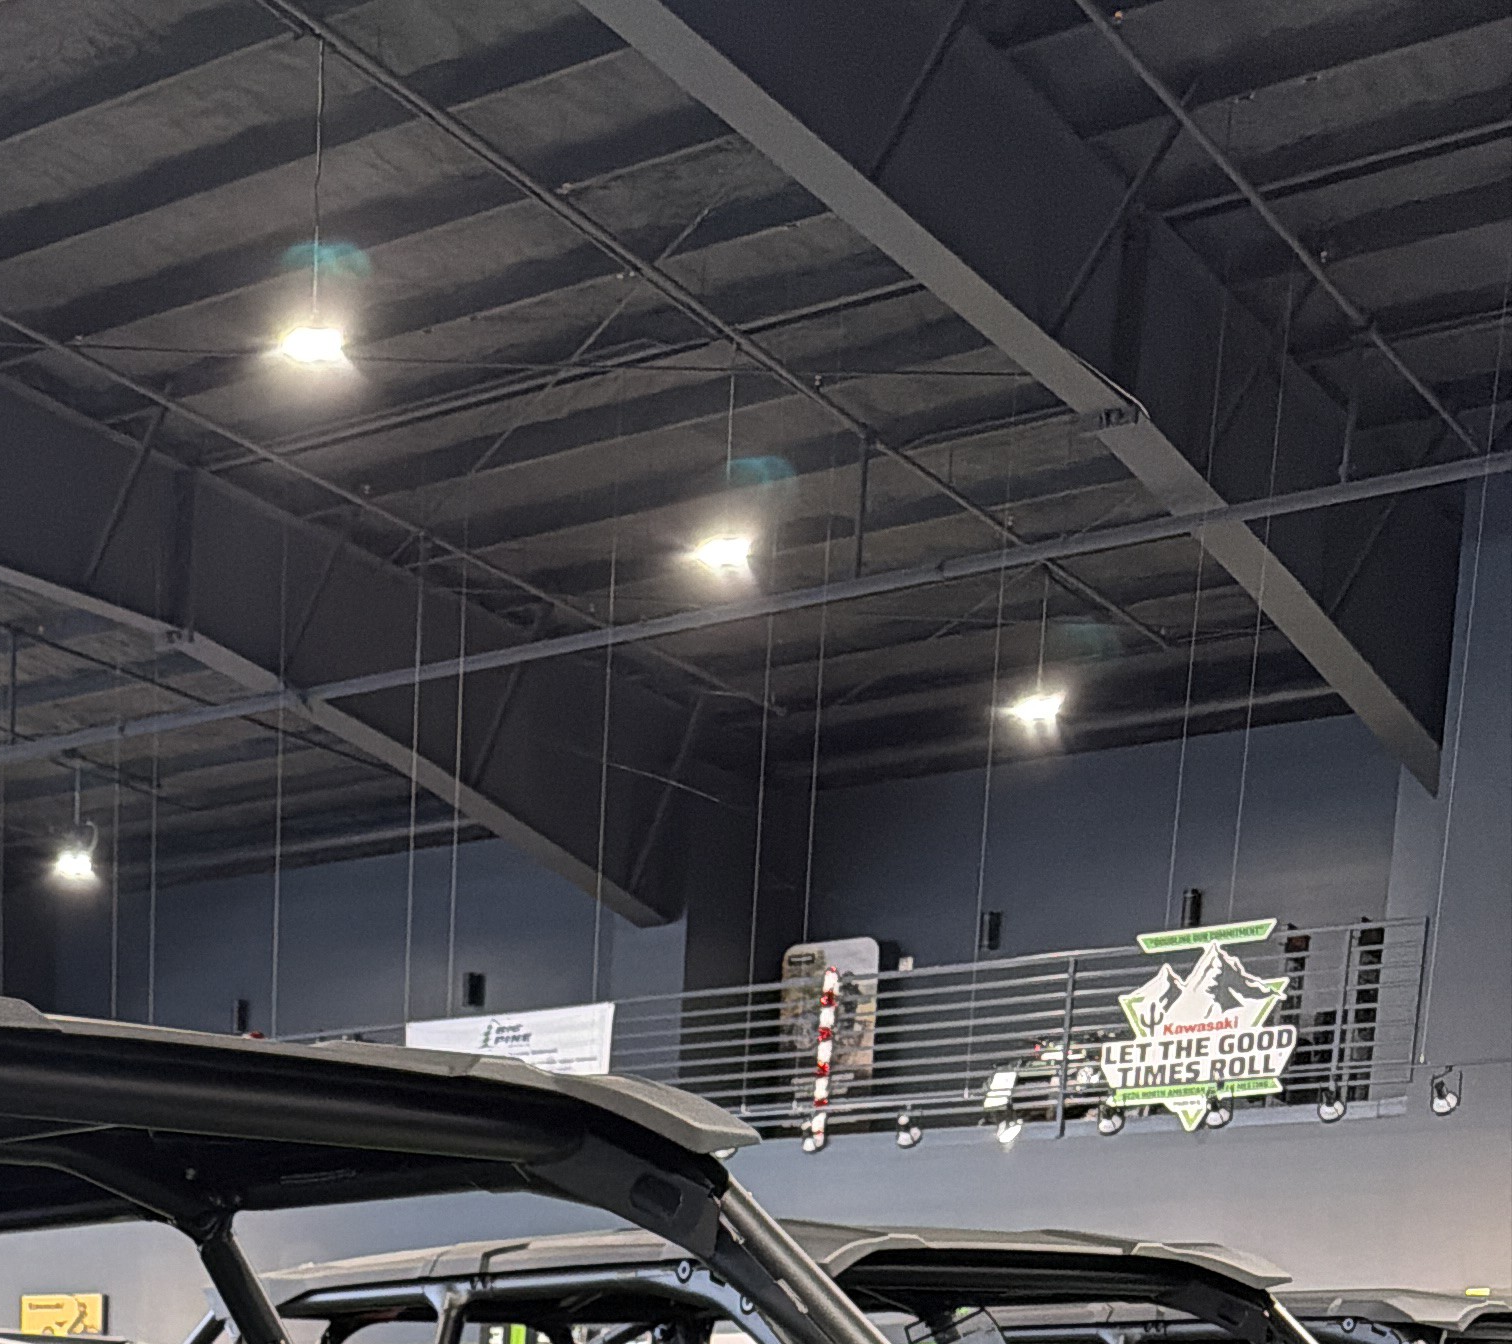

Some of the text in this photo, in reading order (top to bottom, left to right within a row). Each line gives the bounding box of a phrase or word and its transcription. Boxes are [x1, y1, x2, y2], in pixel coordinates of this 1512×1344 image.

[1163, 1016, 1239, 1036] Kawasaki
[1104, 1028, 1293, 1066] LET THE GOOD
[1117, 1053, 1276, 1088] TIMES ROLL
